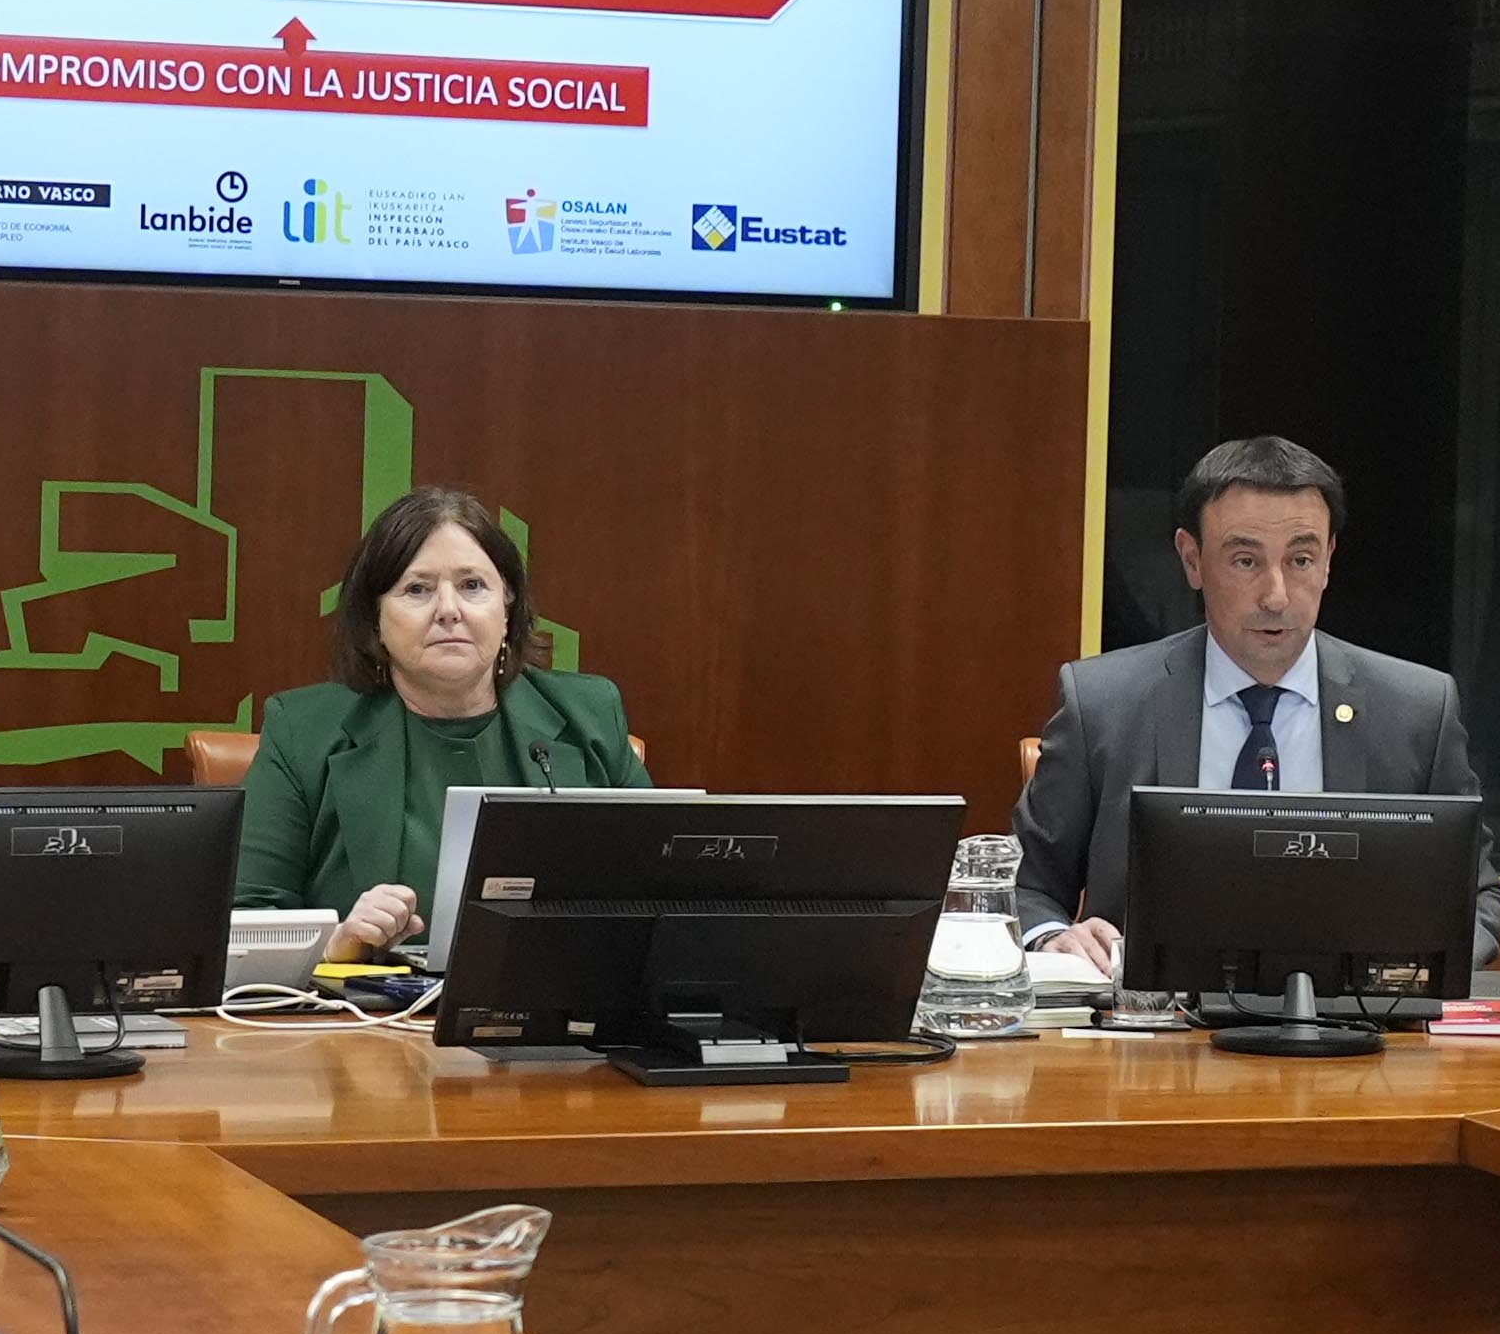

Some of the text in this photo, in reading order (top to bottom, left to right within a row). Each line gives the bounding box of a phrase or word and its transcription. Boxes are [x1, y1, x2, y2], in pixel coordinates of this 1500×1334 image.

[215, 64, 291, 97] CON
[303, 67, 345, 99] LA
[351, 69, 499, 107] JUSTICIA
[506, 76, 626, 113] SOCIAL
[39, 186, 96, 203] VASCO
[369, 189, 465, 201] EUSKADIKO LAN
[369, 201, 444, 212] IKUSKARITZA
[561, 200, 628, 216] OSALAN
[368, 213, 443, 224] INSPECCIÓN
[10, 222, 21, 230] DE
[368, 225, 445, 236] DE TRABAJO
[741, 216, 847, 247] Eustat
[368, 236, 469, 249] DEL PAÍS VASCO
